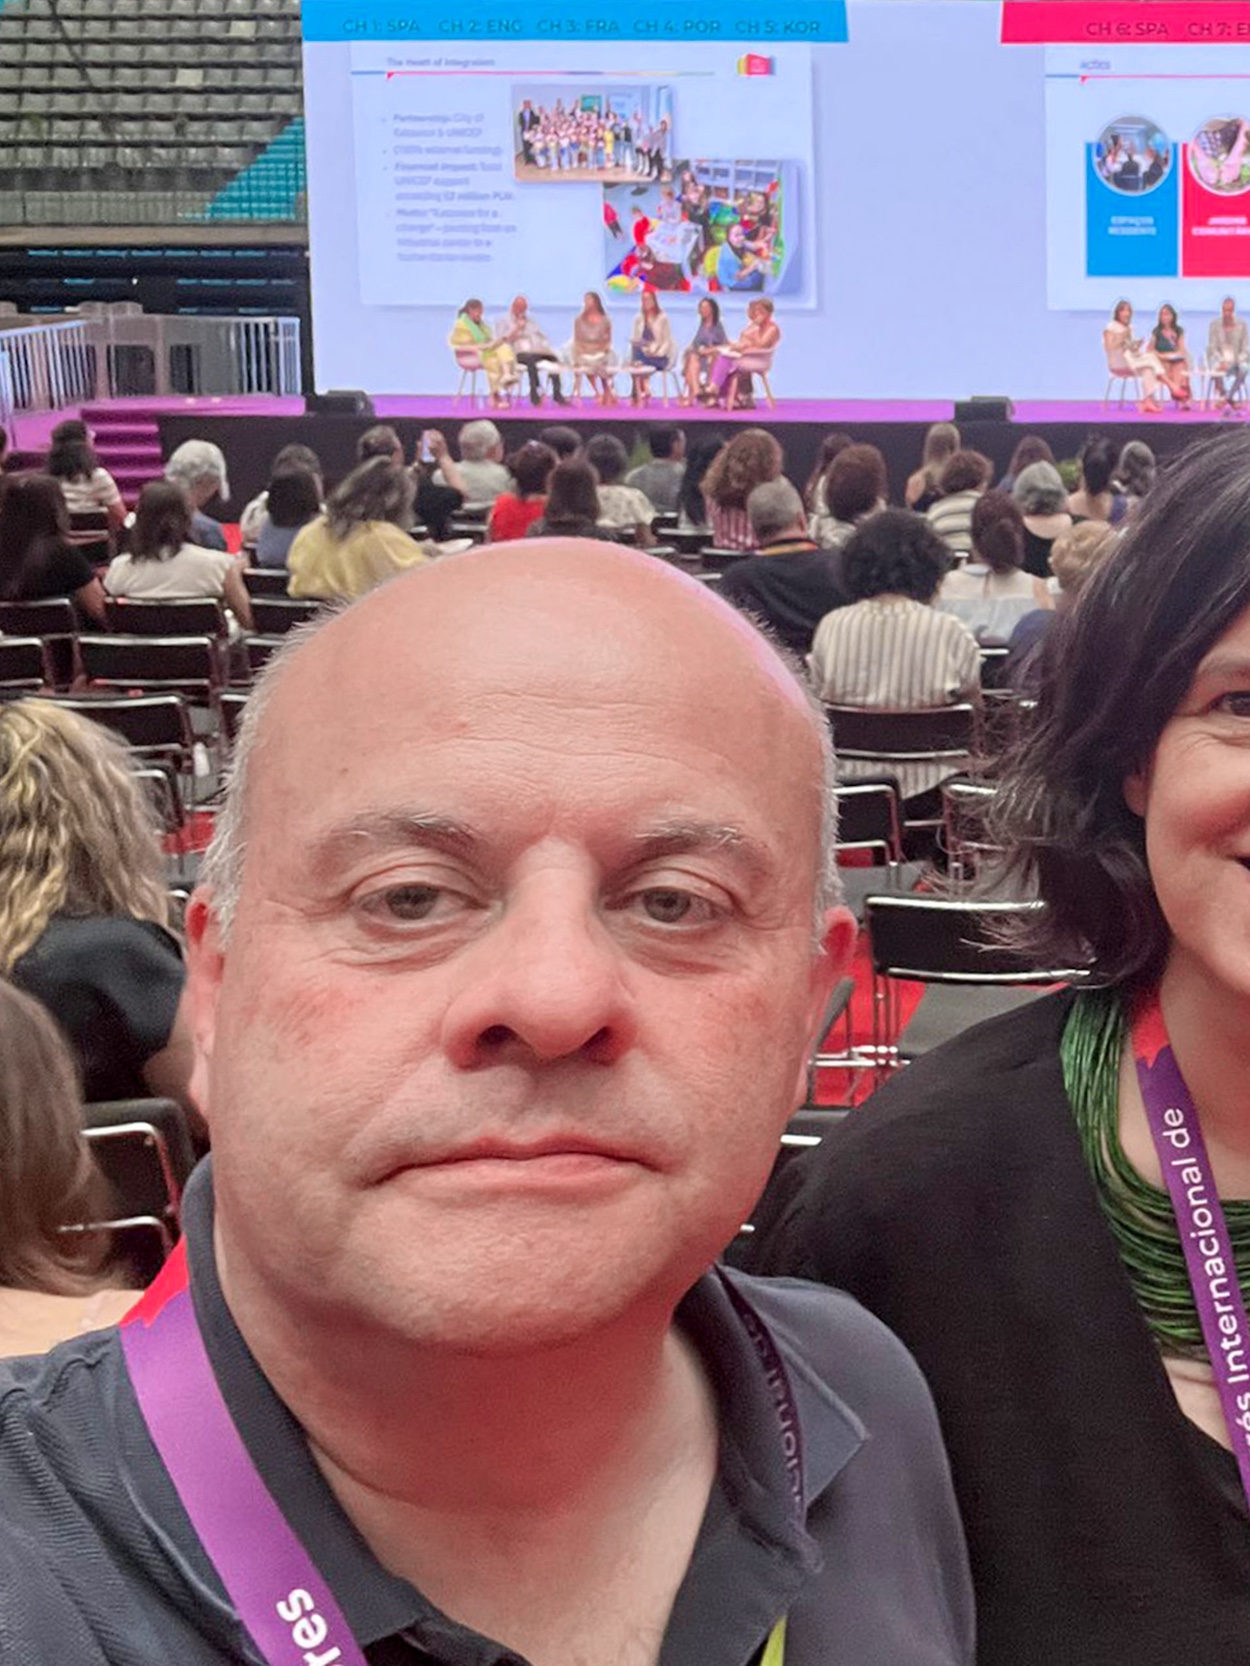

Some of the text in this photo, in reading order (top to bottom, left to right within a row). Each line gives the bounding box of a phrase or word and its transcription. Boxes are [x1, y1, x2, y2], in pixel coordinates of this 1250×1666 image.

[343, 20, 367, 33] CH
[387, 20, 420, 33] SPA
[438, 20, 463, 33] CH
[487, 20, 523, 33] ENG
[538, 20, 561, 33] CH
[586, 20, 620, 33] FRA
[633, 20, 658, 33] CH
[684, 20, 721, 33] POR
[735, 20, 760, 33] CH
[784, 20, 820, 33] KOR
[1086, 22, 1169, 36] CH 6: SPA
[1188, 22, 1212, 36] CH
[1217, 22, 1231, 36] 7:
[1162, 1108, 1190, 1149] de
[1171, 1157, 1250, 1383] Internacional
[276, 1588, 341, 1666] res
